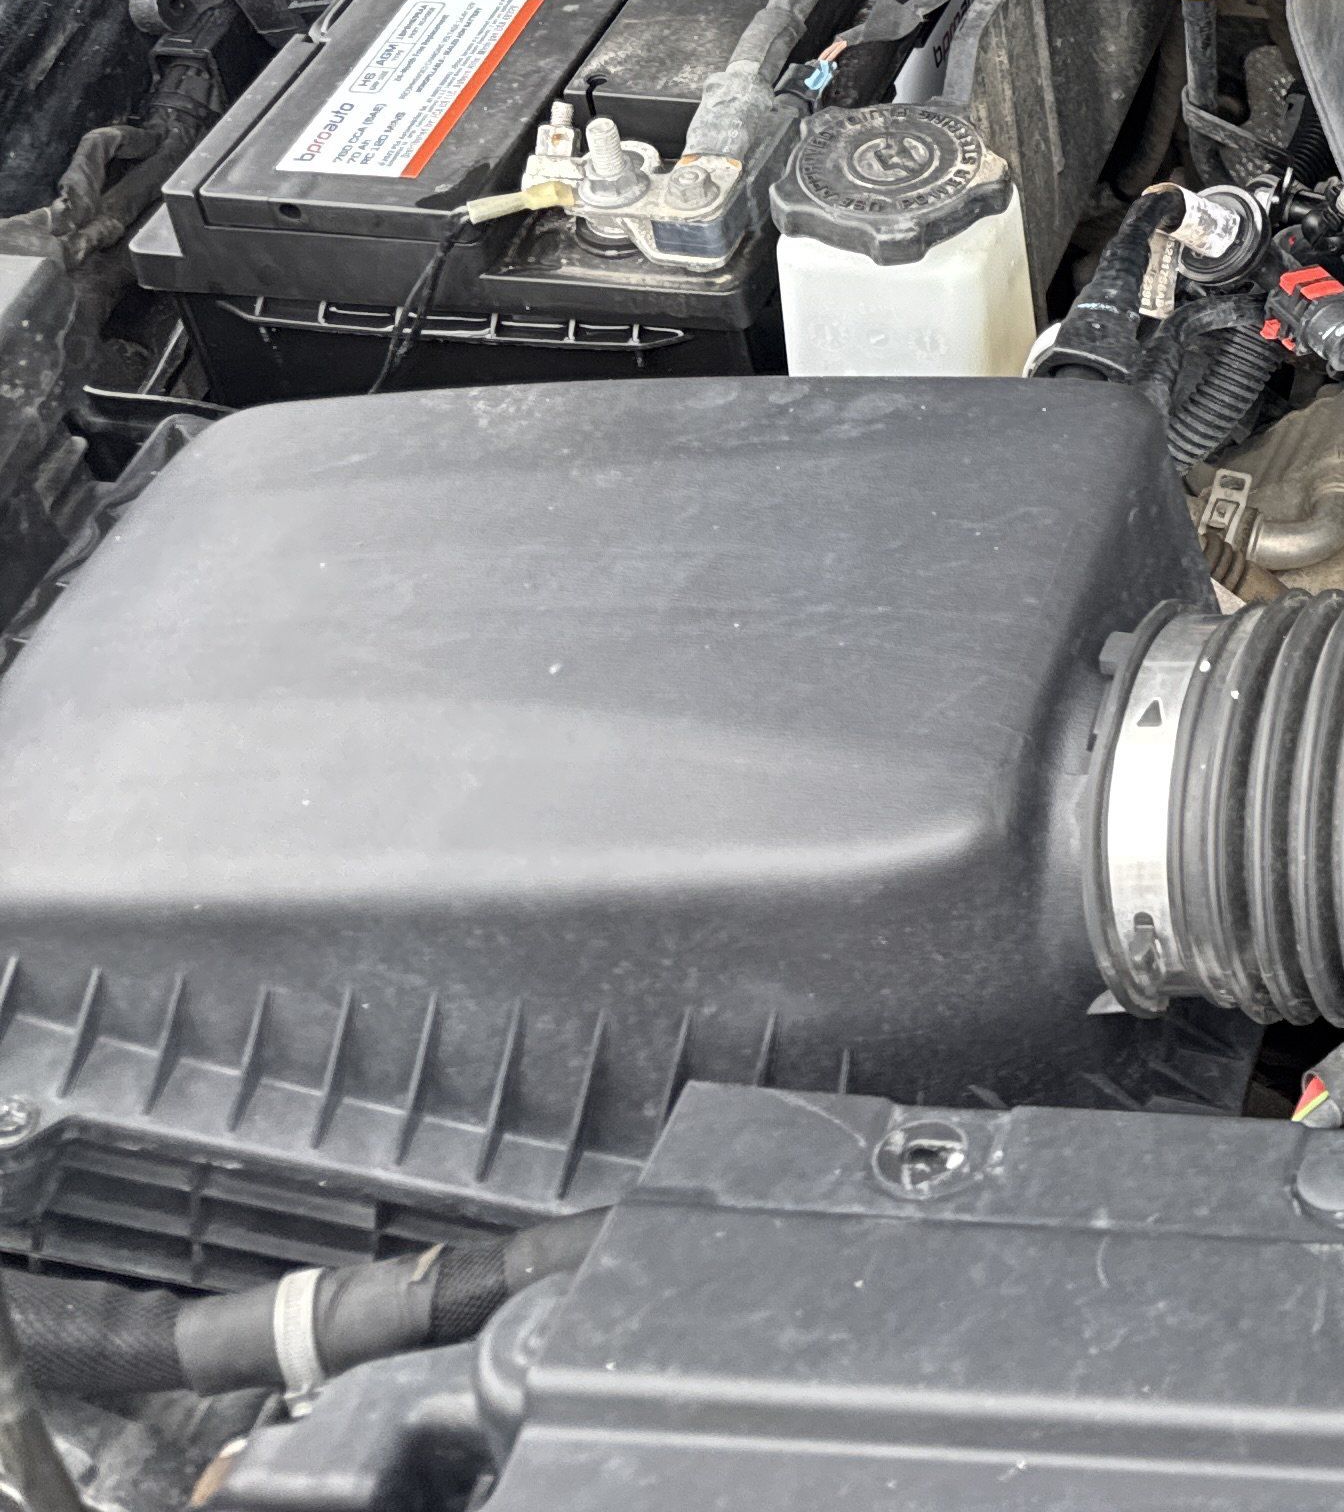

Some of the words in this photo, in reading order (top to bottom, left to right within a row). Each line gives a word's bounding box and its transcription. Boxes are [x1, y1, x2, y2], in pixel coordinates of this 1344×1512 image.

[292, 102, 356, 162] bproauto
[916, 108, 976, 166] STEERING
[896, 166, 971, 211] POWER
